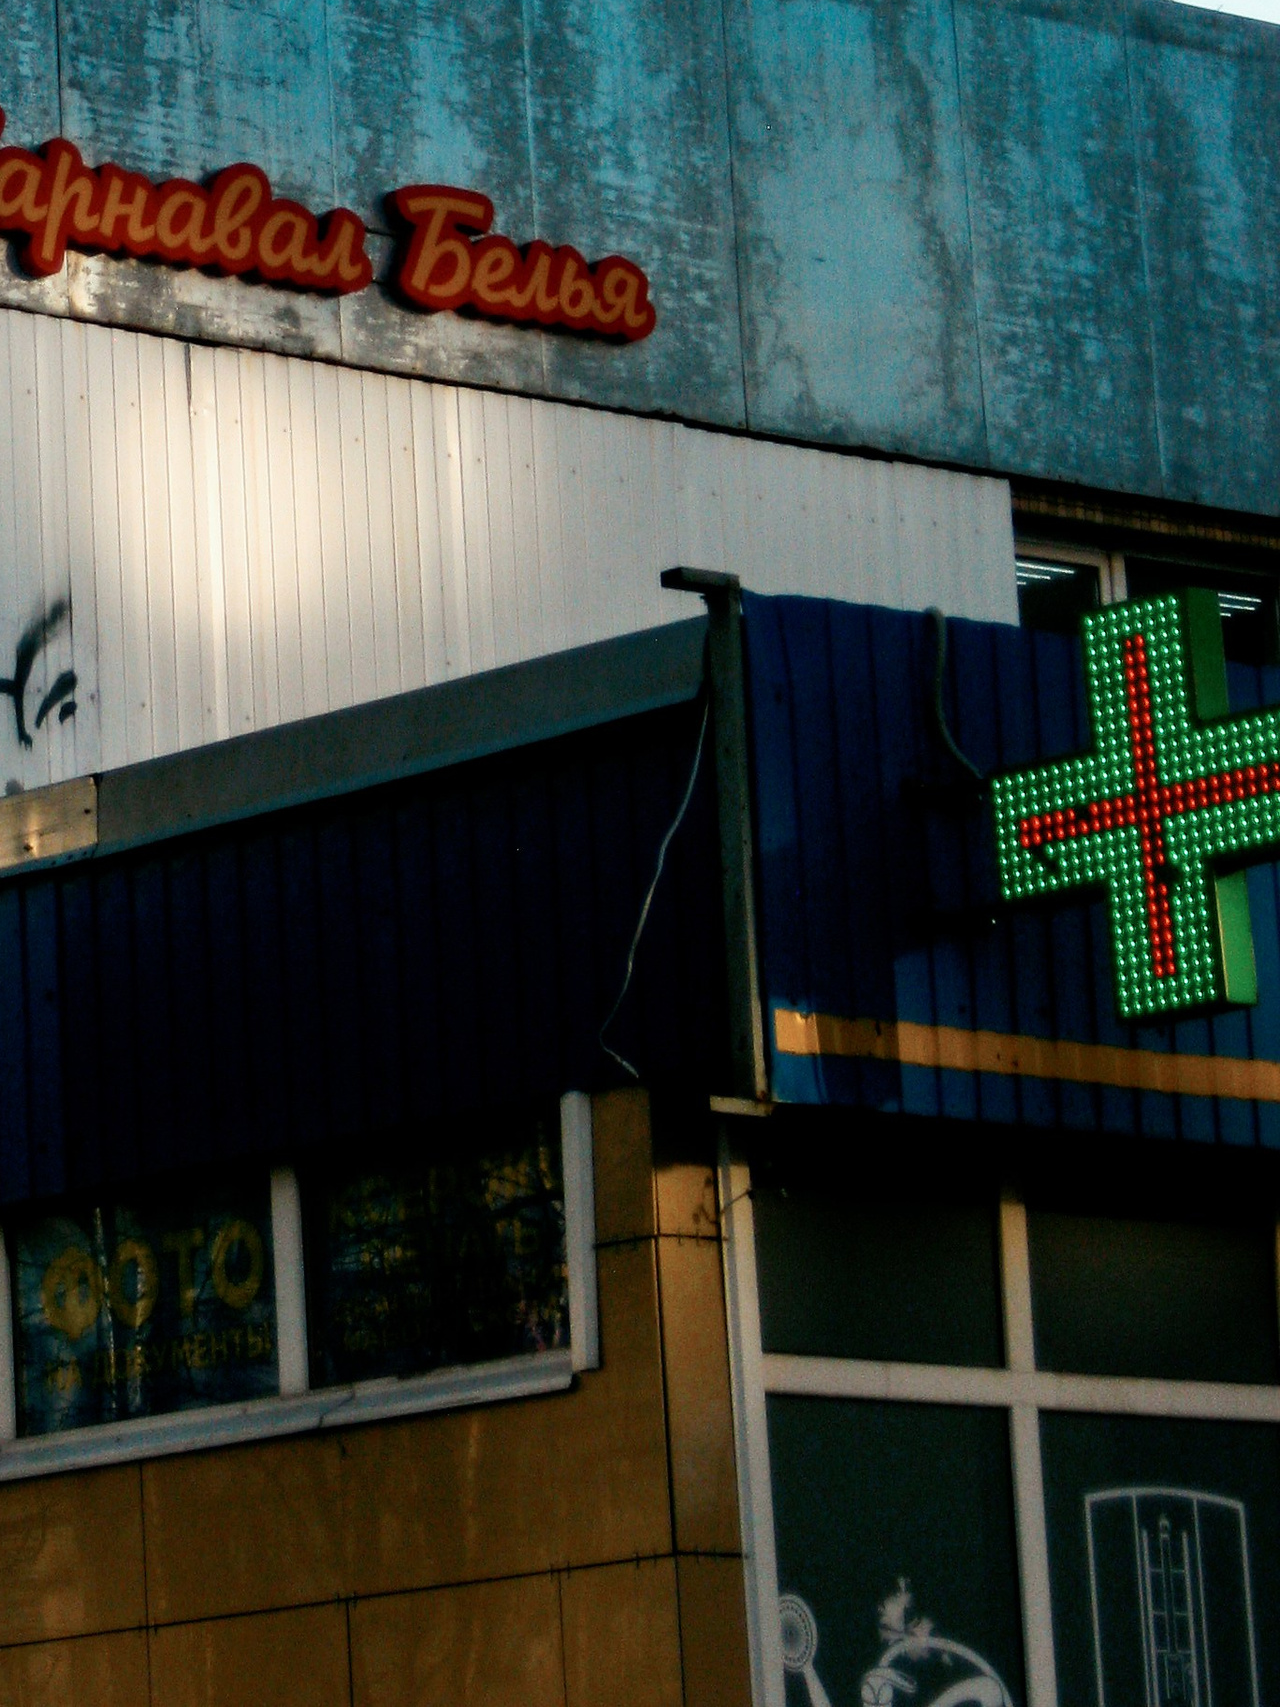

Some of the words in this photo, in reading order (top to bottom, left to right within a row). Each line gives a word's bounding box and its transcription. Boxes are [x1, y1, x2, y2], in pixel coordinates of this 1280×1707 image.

[402, 193, 650, 334] Белья
[42, 1218, 265, 1342] ФОТО
[93, 1322, 273, 1389] ДОКУМЕНТЫ
